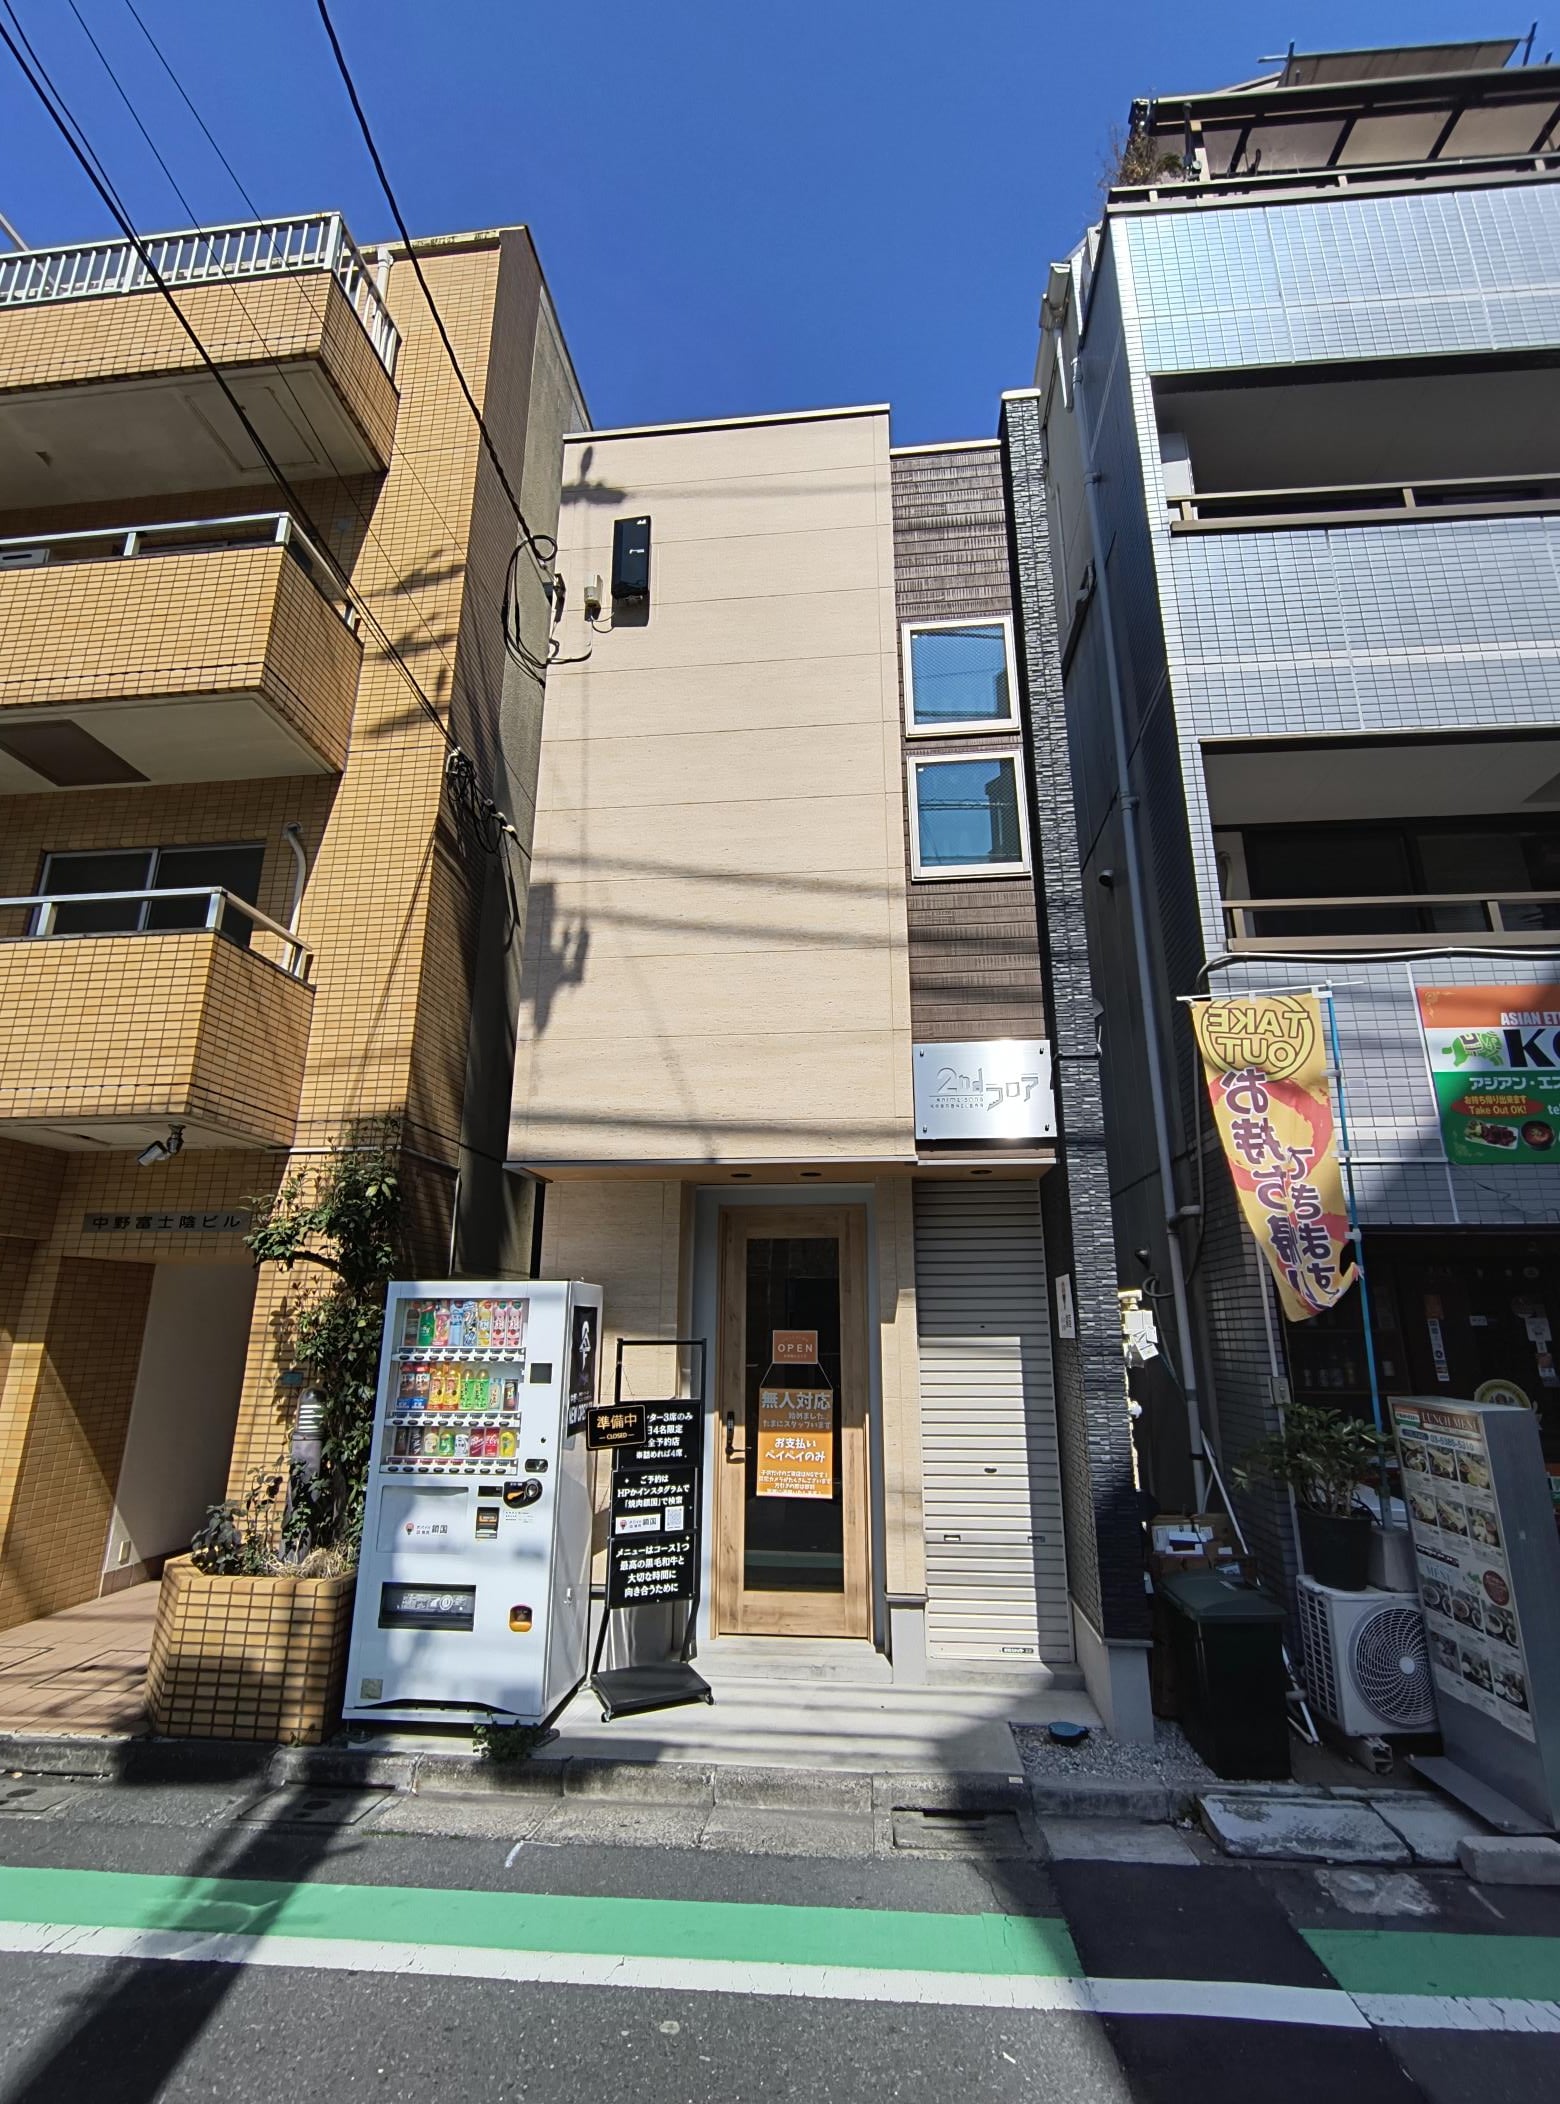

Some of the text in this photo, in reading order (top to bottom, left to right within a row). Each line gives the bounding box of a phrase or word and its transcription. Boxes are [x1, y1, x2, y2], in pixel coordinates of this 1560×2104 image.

[1501, 1012, 1541, 1026] ASIAN
[1503, 1029, 1560, 1067] K
[1469, 1106, 1527, 1114] Take Out OK!
[777, 1344, 813, 1353] OPEN
[761, 1391, 831, 1410] 無人対応
[596, 1413, 637, 1430] 準備中
[647, 1412, 693, 1423] ター3席のみ
[606, 1432, 628, 1440] CLOSED
[642, 1437, 680, 1447] 全予約店
[775, 1437, 817, 1449] お支払い
[765, 1450, 826, 1463] ペイペイのみ
[640, 1475, 669, 1484] ご予約は
[617, 1484, 690, 1498] HPかインスタグラムで
[616, 1543, 690, 1558] メニューはコース1つ
[620, 1556, 685, 1571] 最高の黒毛和牛と
[627, 1570, 677, 1584] 大切な時間に
[624, 1583, 679, 1598] 向き合うために
